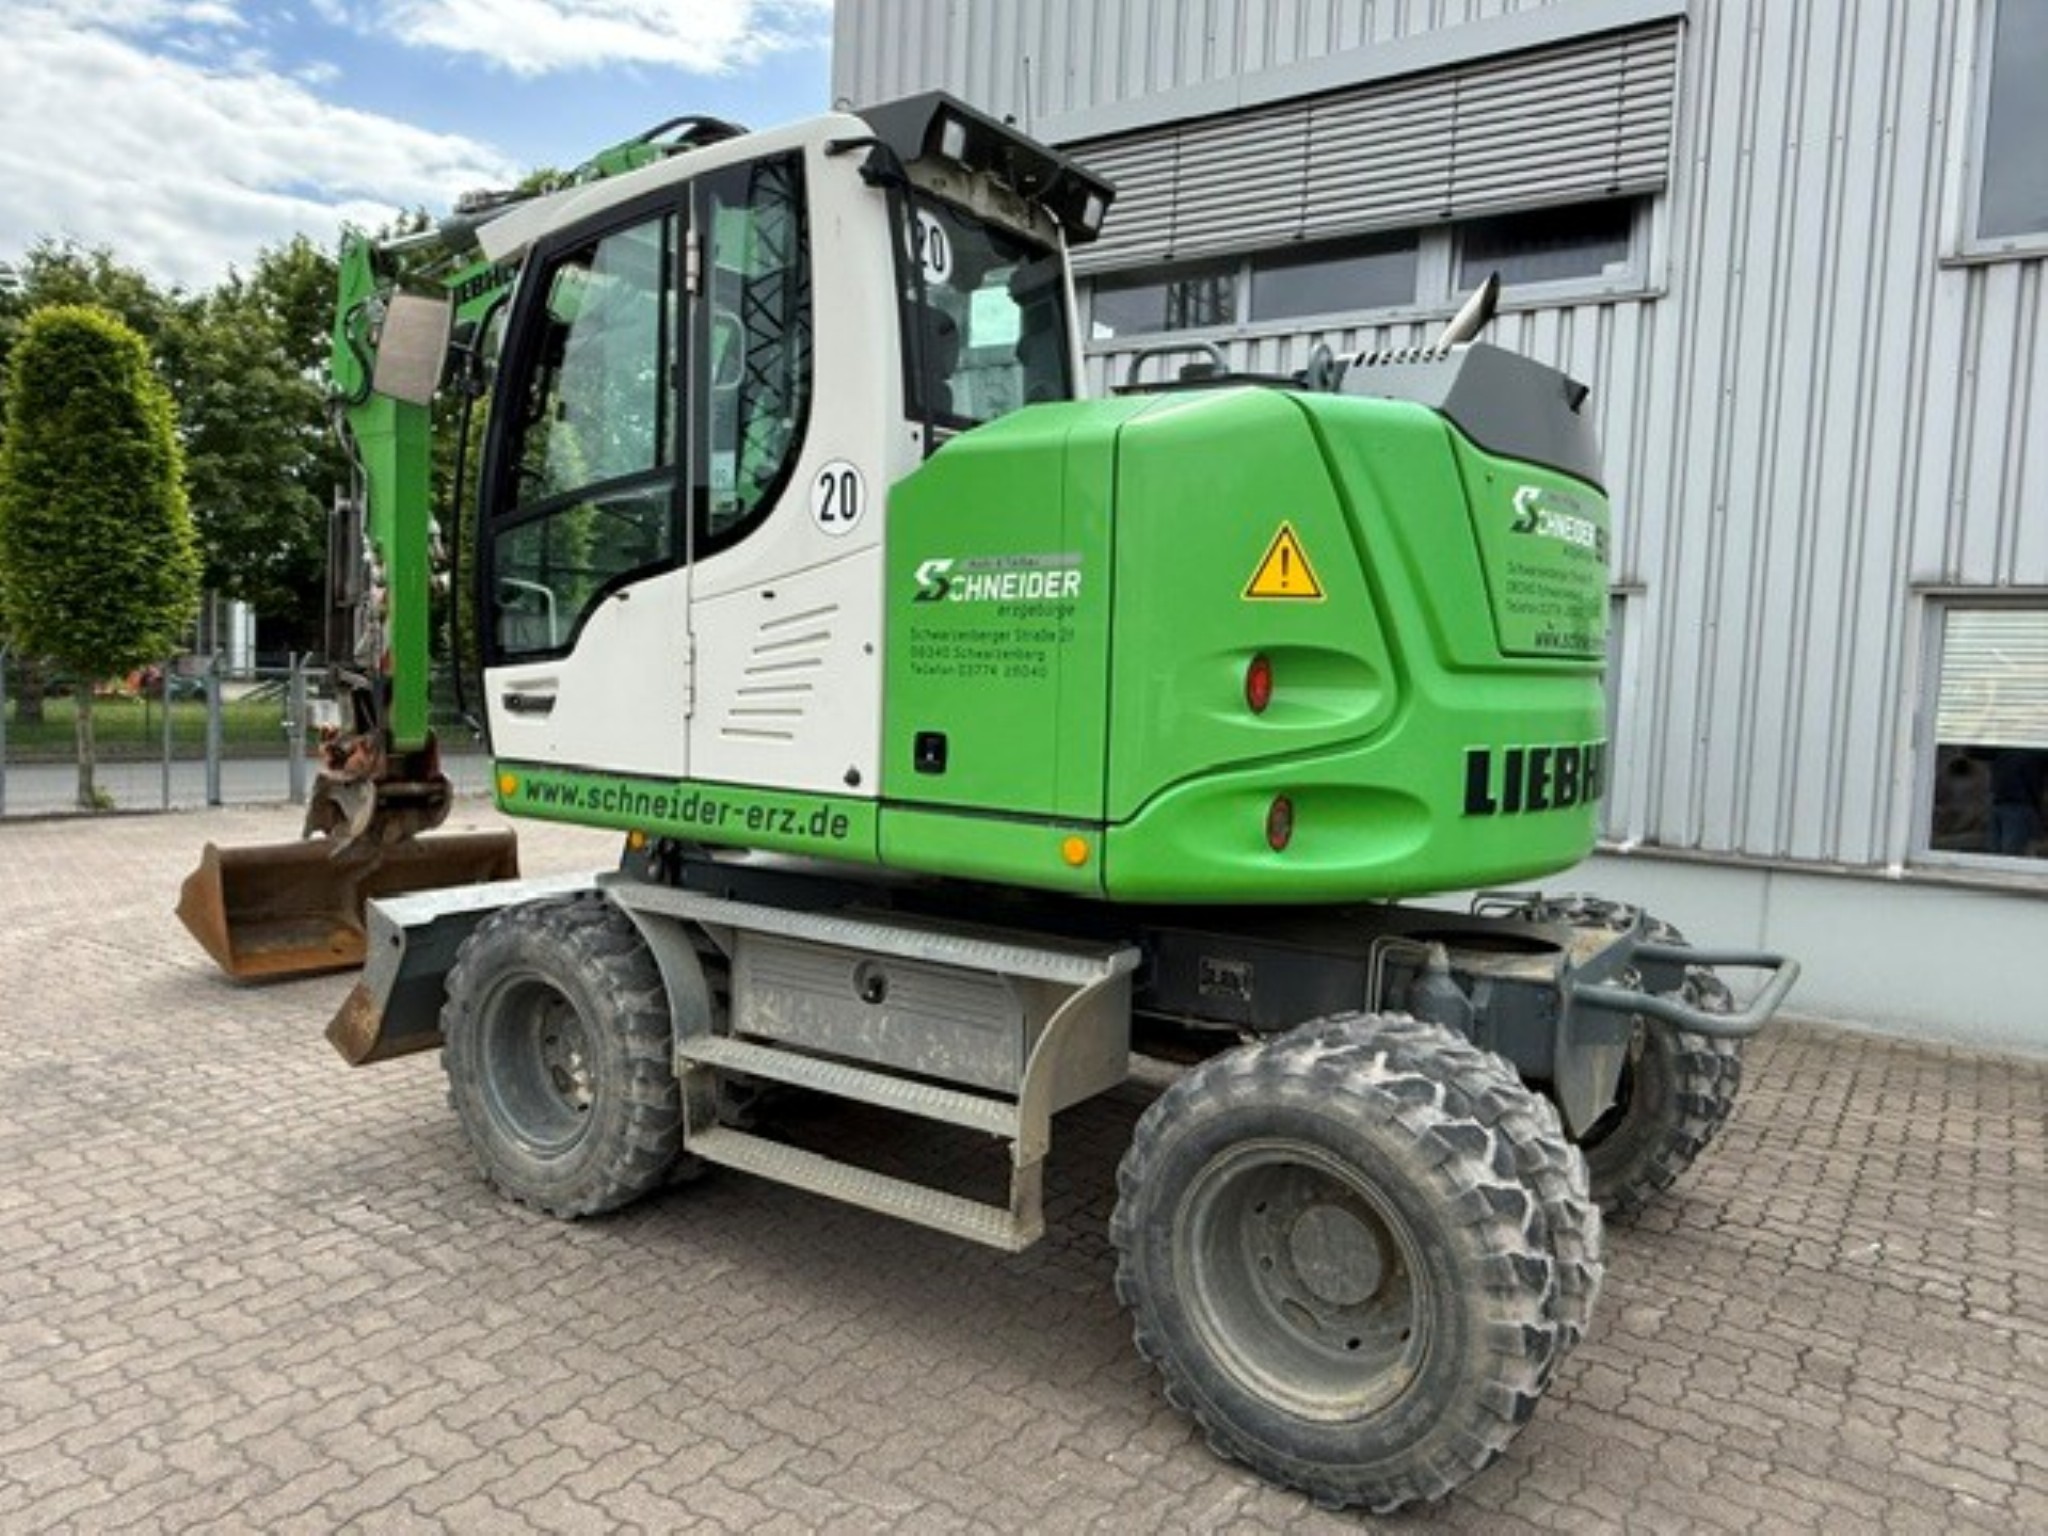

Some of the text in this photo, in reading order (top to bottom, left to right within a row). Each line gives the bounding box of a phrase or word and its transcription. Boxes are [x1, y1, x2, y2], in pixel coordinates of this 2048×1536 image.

[820, 470, 857, 521] 20
[913, 557, 1082, 603] SCHNEIDER
[525, 779, 850, 838] www.schneider-erz.de
